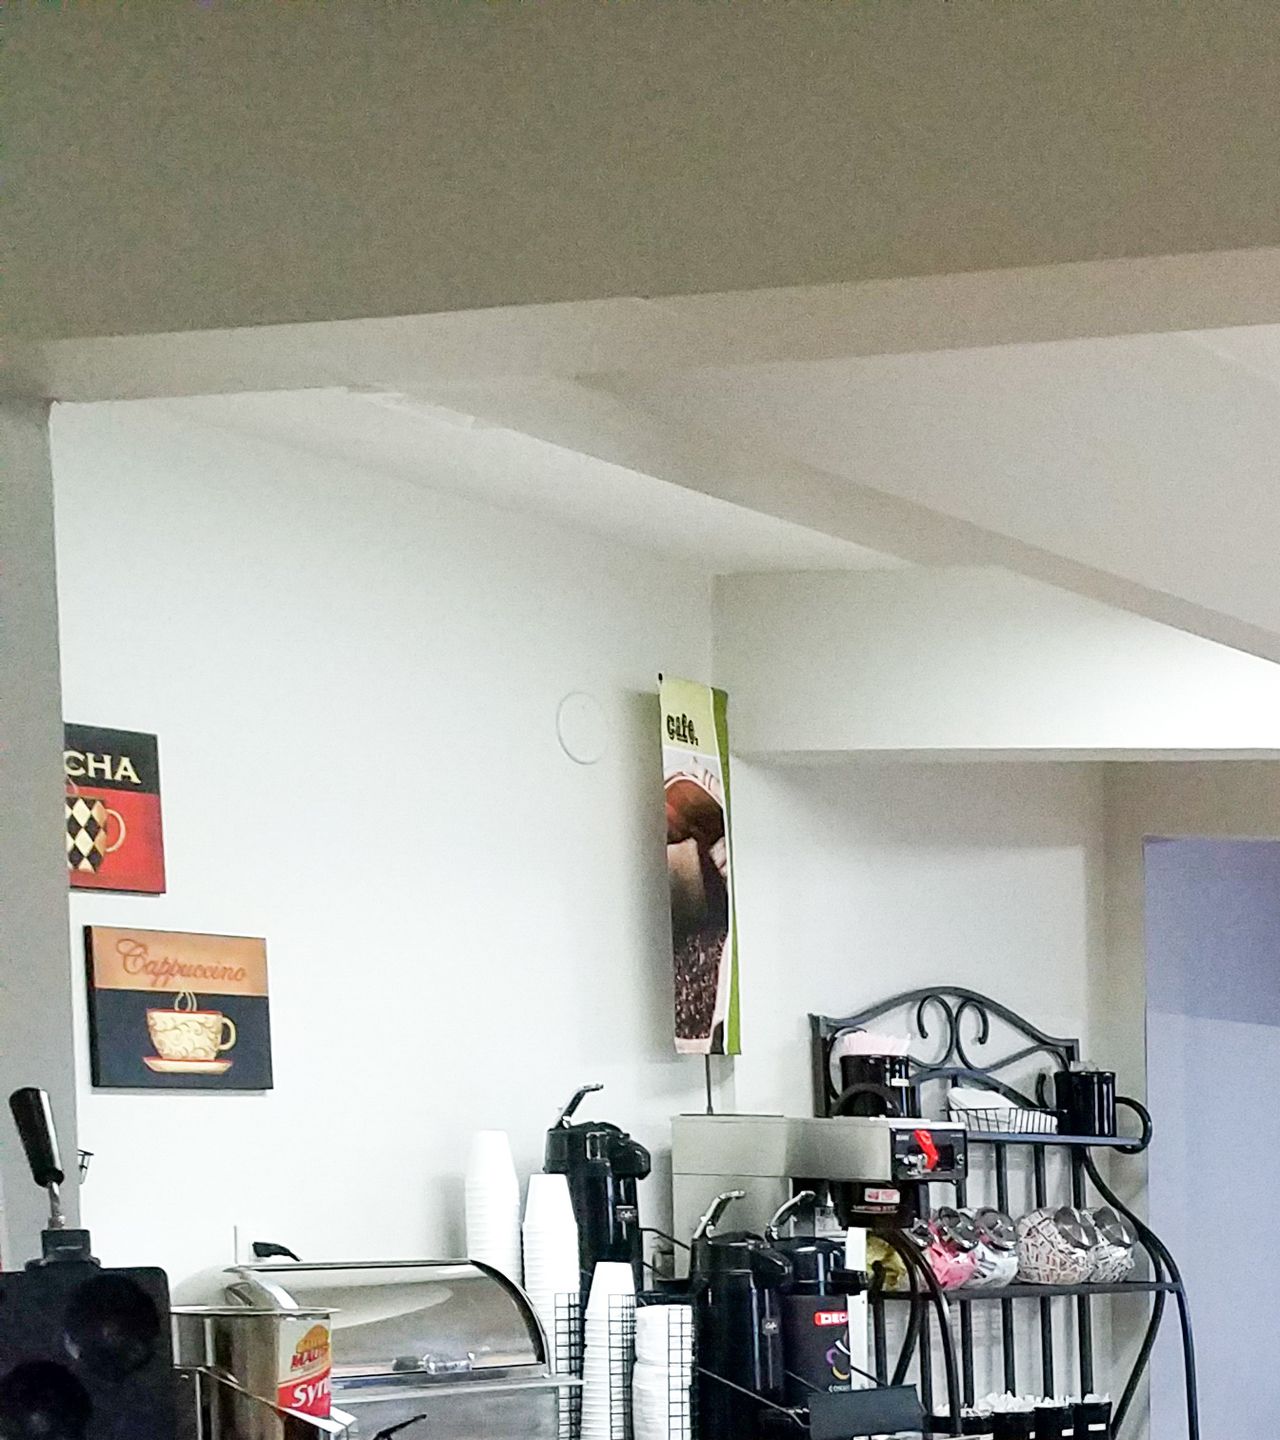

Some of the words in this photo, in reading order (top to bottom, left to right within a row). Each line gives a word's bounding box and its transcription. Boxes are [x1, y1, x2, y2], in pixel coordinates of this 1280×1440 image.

[63, 750, 142, 784] CHA
[116, 939, 247, 987] Cappuccino
[820, 1312, 849, 1325] DEC
